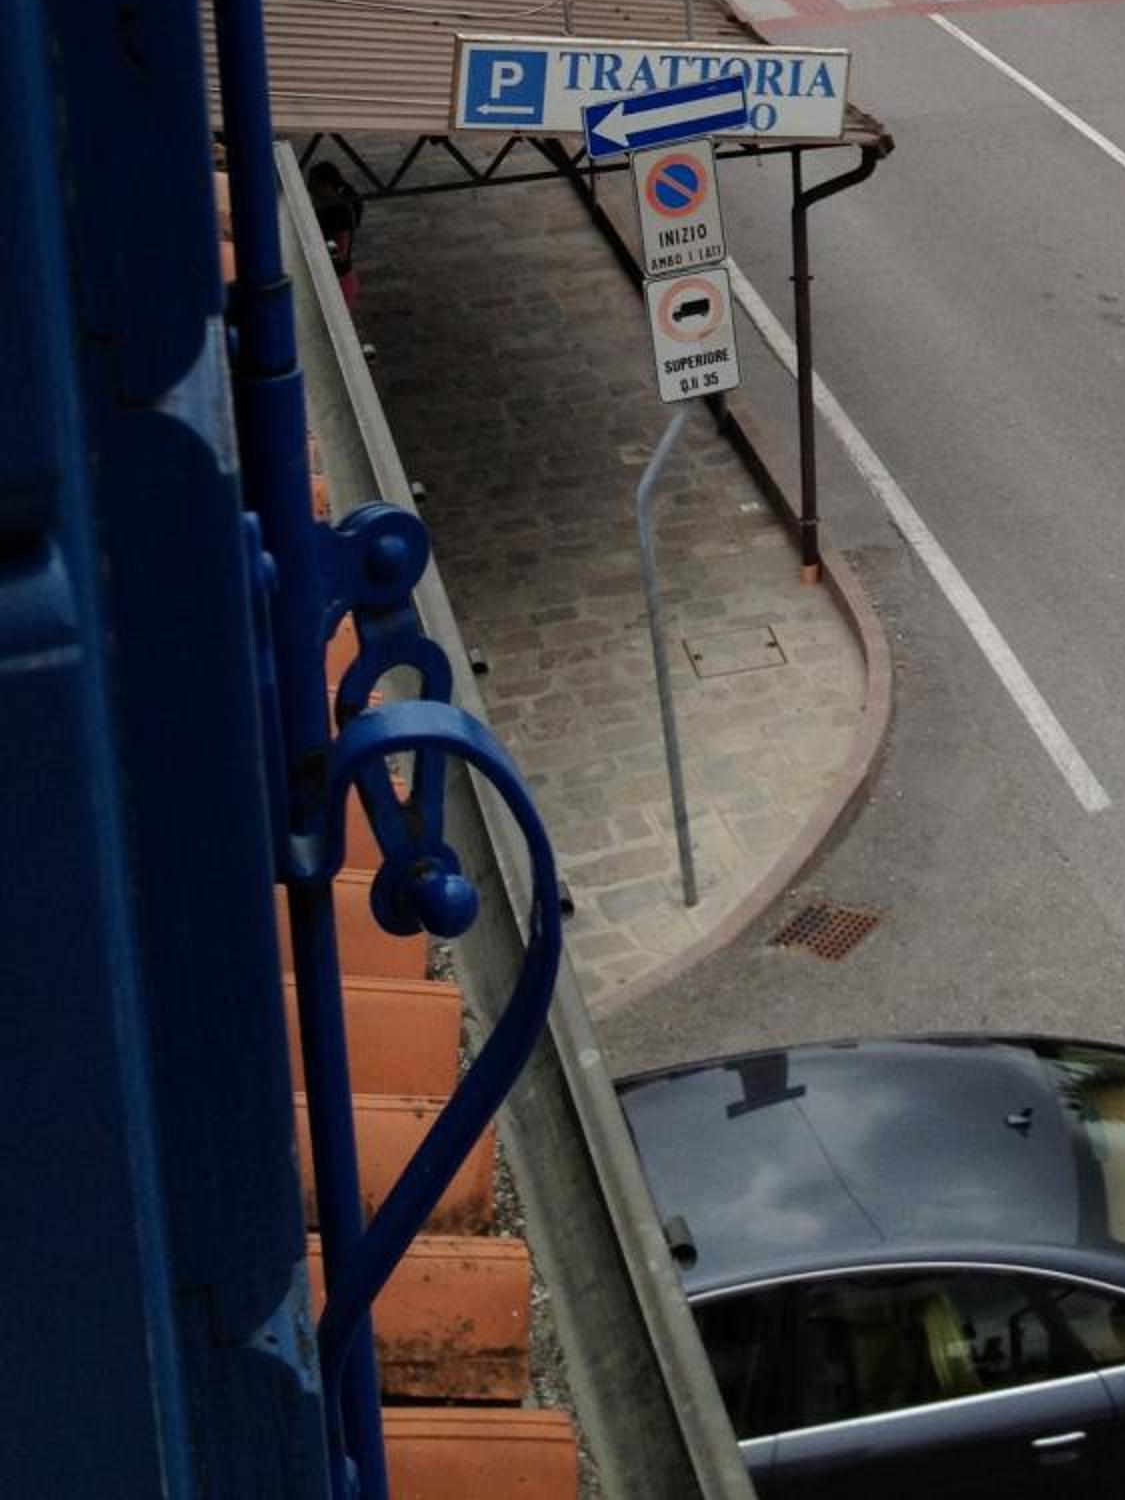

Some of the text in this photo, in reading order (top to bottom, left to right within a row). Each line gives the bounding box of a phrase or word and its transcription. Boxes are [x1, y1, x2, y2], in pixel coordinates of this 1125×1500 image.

[491, 61, 525, 99] P
[659, 223, 707, 248] INIZIO
[651, 251, 682, 270] AMBO
[664, 348, 730, 375] SUPERIORE
[703, 372, 719, 387] 35
